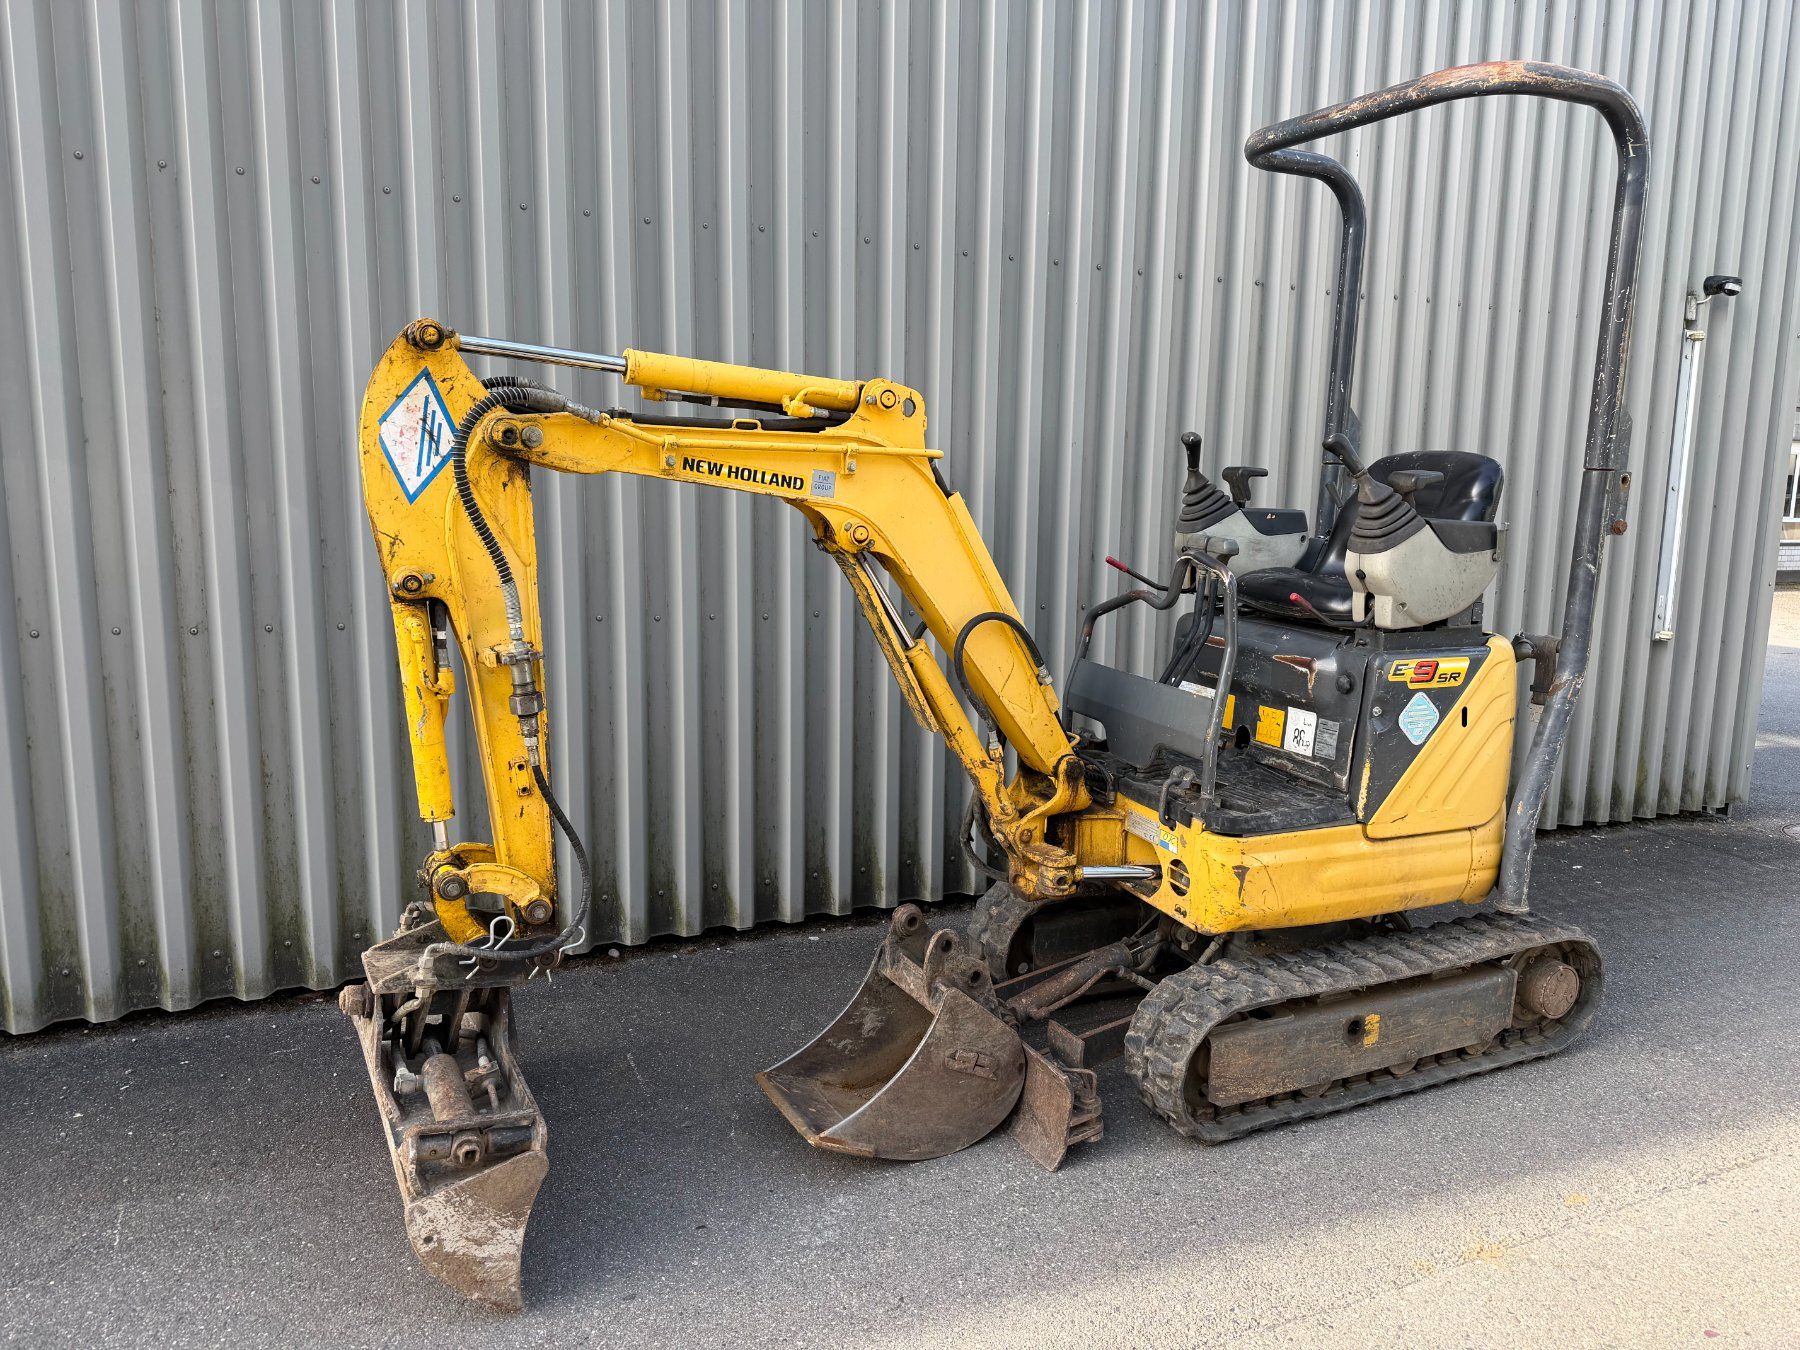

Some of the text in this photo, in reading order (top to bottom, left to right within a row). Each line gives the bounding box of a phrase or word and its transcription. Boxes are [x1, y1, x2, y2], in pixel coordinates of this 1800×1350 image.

[682, 456, 805, 491] NEW HOLLAND
[813, 483, 832, 491] GROUP
